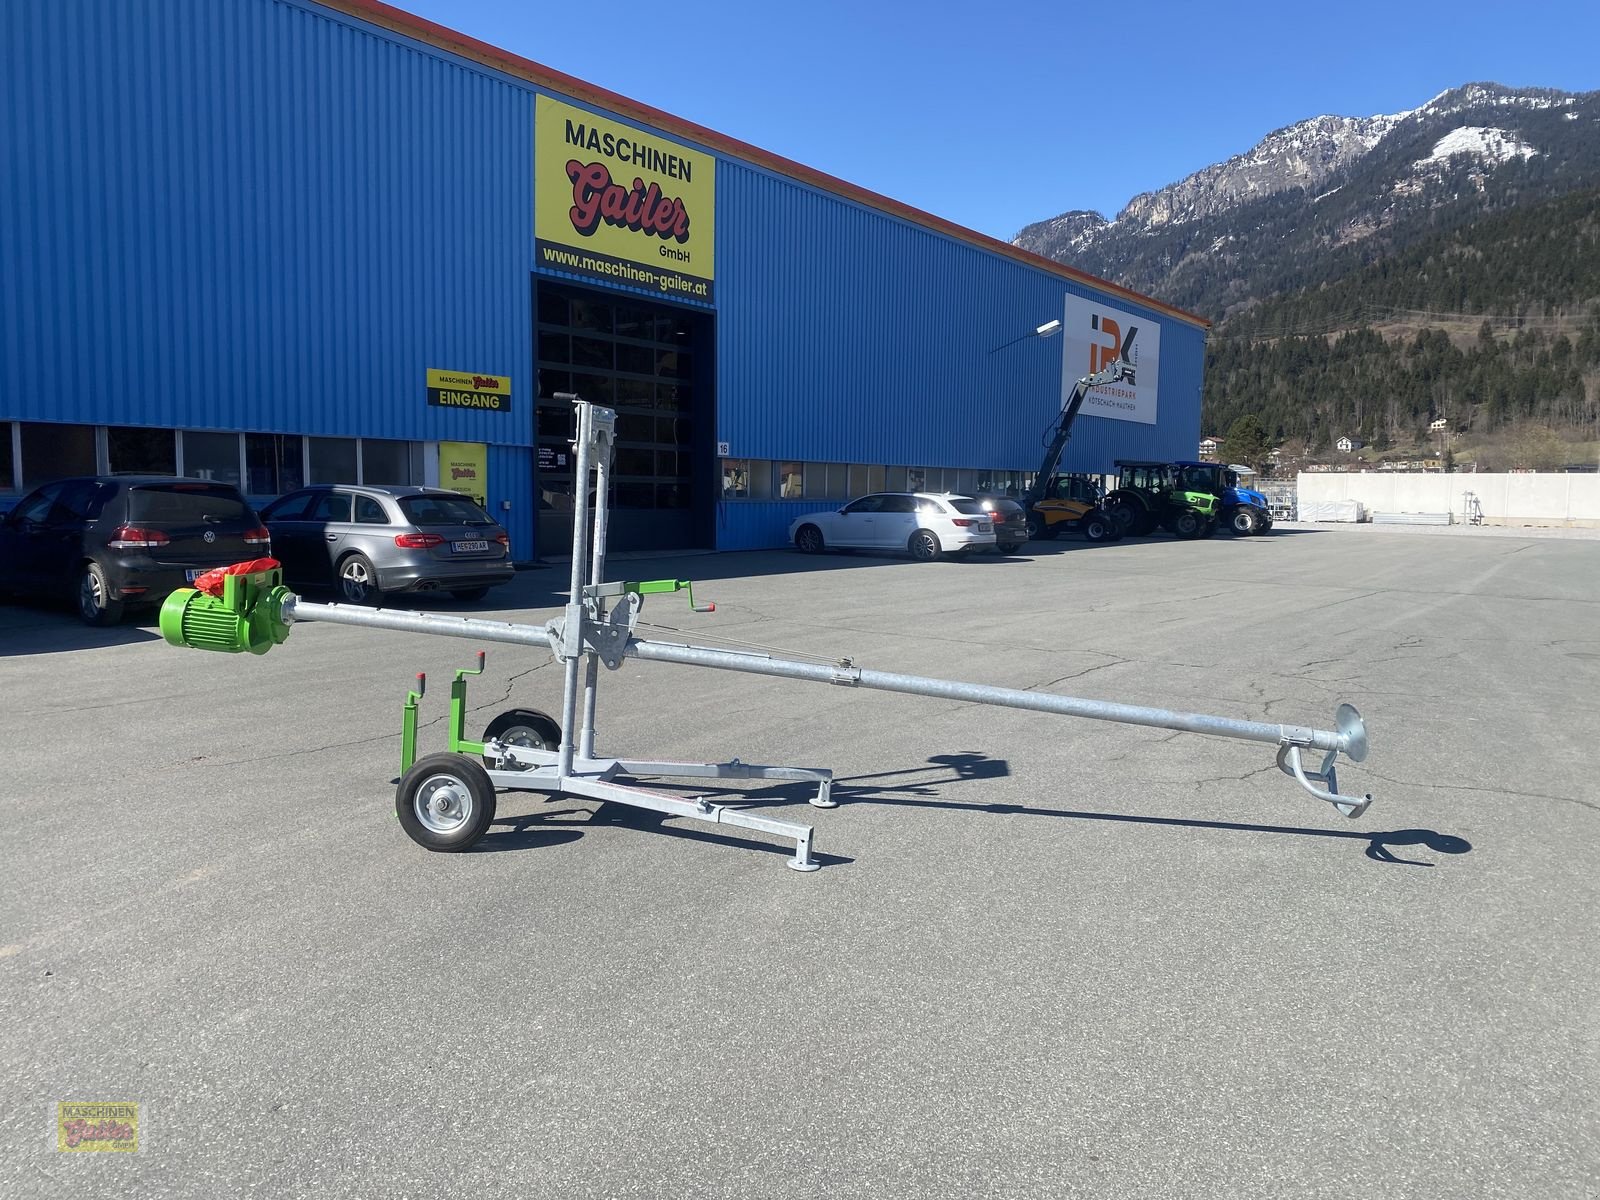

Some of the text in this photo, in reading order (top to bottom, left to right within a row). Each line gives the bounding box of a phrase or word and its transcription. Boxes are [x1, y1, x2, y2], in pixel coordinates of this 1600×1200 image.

[566, 119, 692, 182] MASCHINEN
[566, 159, 690, 244] Gailer
[659, 245, 691, 263] GmbH
[543, 247, 707, 296] www.maschinen-gailer.at
[439, 376, 473, 385] MASCHINEN
[439, 391, 500, 409] EINGANG
[720, 444, 728, 454] 16
